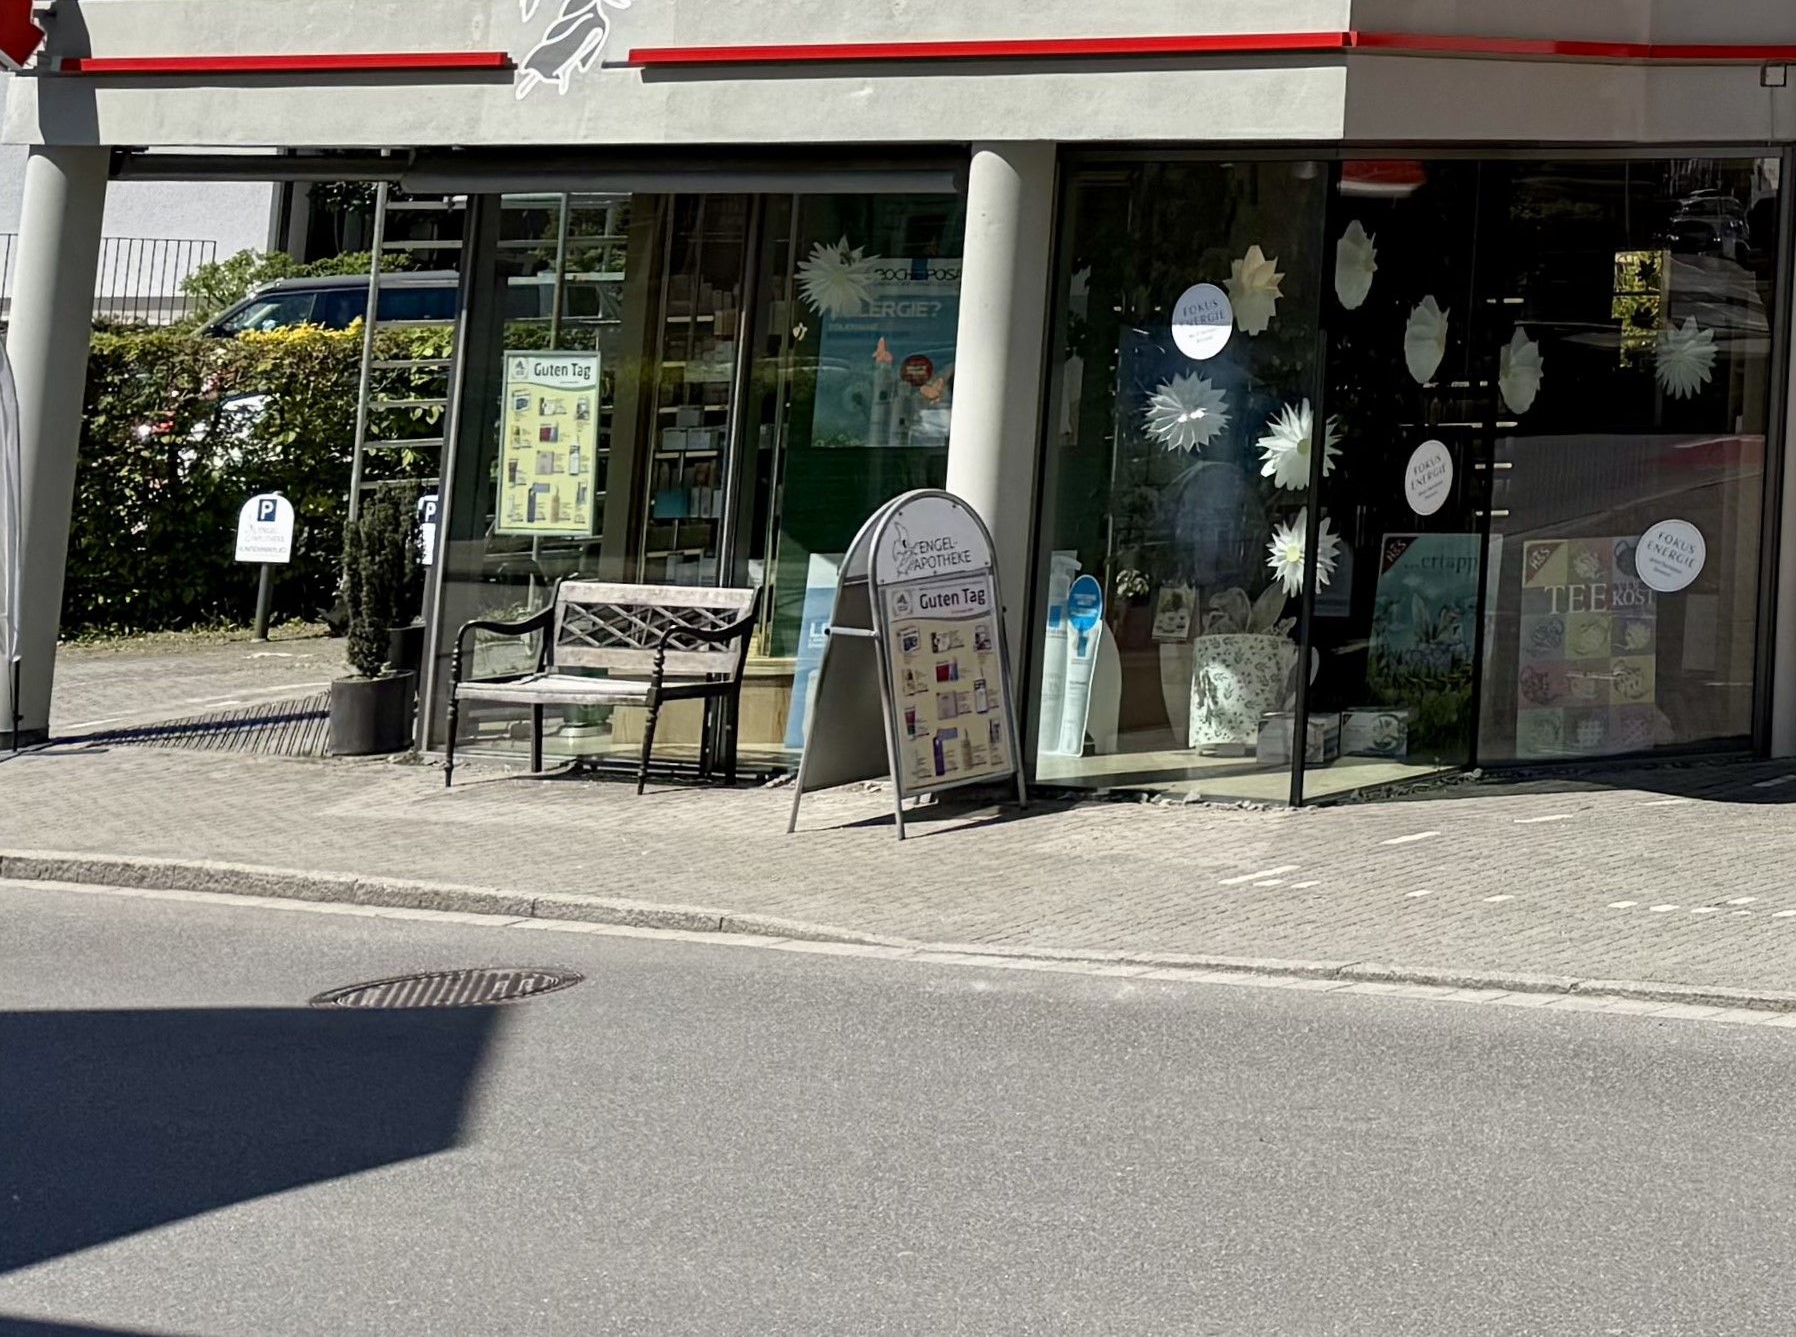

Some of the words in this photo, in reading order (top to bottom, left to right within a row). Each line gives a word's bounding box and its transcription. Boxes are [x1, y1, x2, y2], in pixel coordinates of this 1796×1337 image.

[534, 362, 569, 377] Guten
[571, 362, 591, 380] Tag
[261, 501, 274, 520] P
[919, 537, 958, 554] ENGEL-
[1659, 531, 1695, 555] FOKUS
[914, 550, 972, 571] APOTHEKE
[1647, 540, 1695, 568] ENERGIE
[920, 593, 959, 609] Guten
[962, 588, 986, 605] Tag
[1543, 583, 1607, 615] TEE
